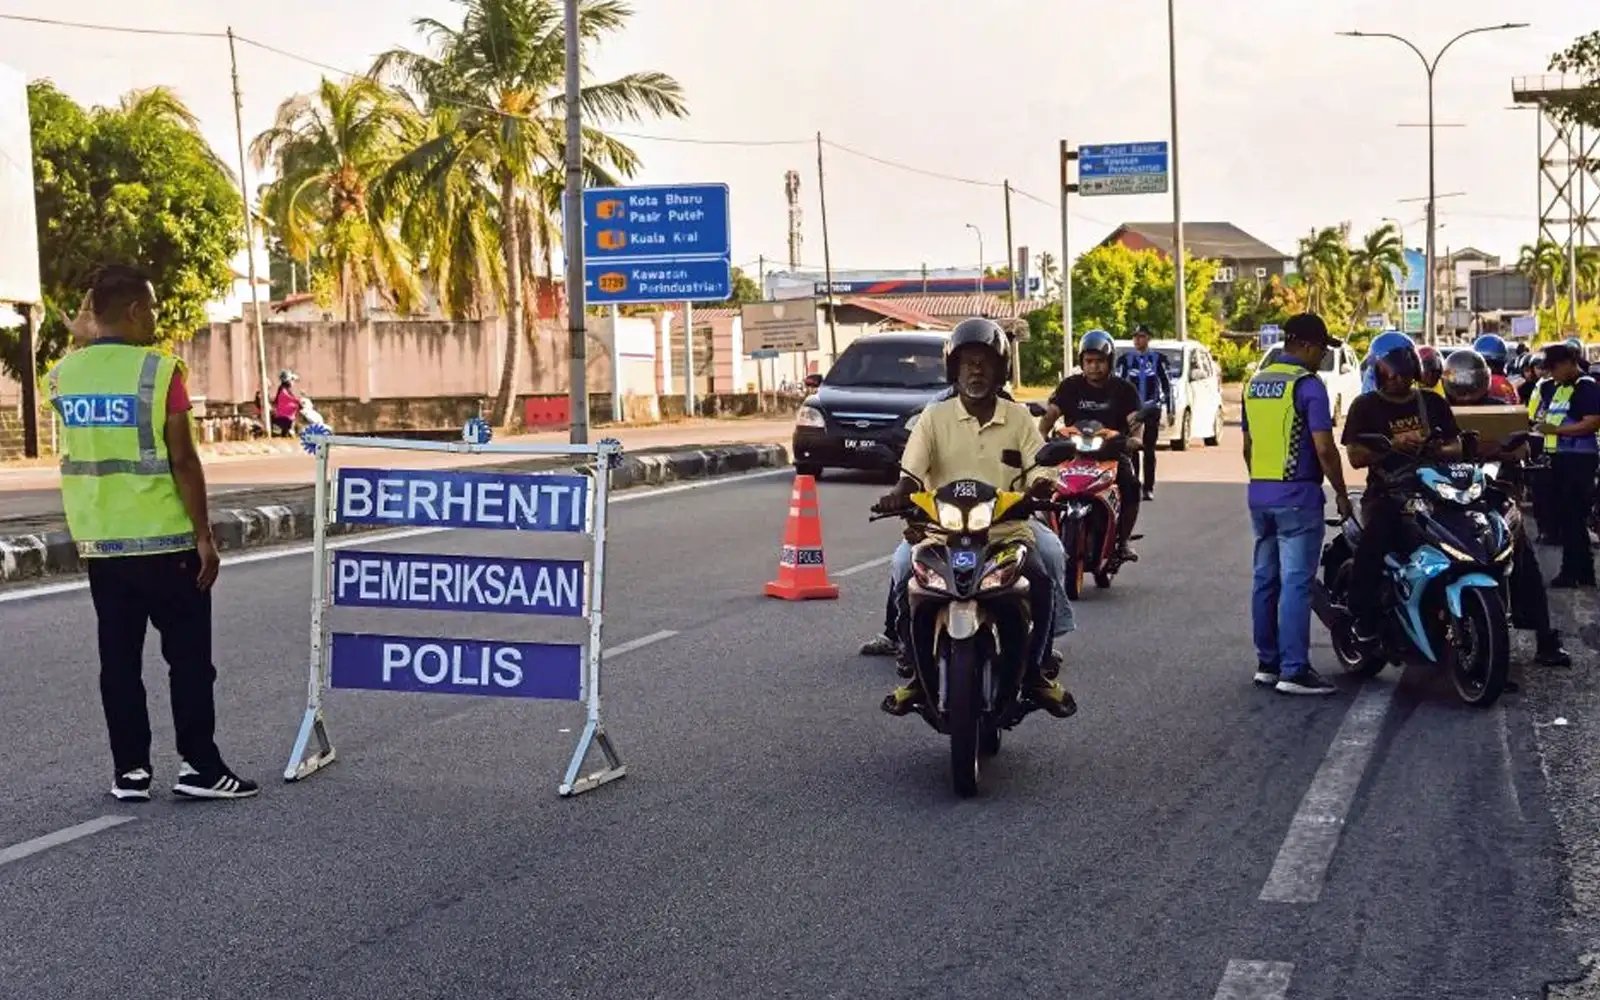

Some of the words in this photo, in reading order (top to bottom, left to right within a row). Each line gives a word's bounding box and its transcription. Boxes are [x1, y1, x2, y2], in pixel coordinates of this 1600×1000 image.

[629, 195, 658, 206] Kota
[665, 194, 703, 205] Bharu
[630, 211, 661, 223] Pasir
[668, 210, 704, 222] Puteh
[631, 233, 665, 244] Kuala
[1249, 382, 1284, 398] POLIS
[62, 398, 130, 423] POLIS
[342, 477, 582, 526] BERHENTI
[799, 551, 822, 563] POLIS
[338, 558, 579, 608] PEMERIKSAAN
[382, 643, 524, 688] POLIS
